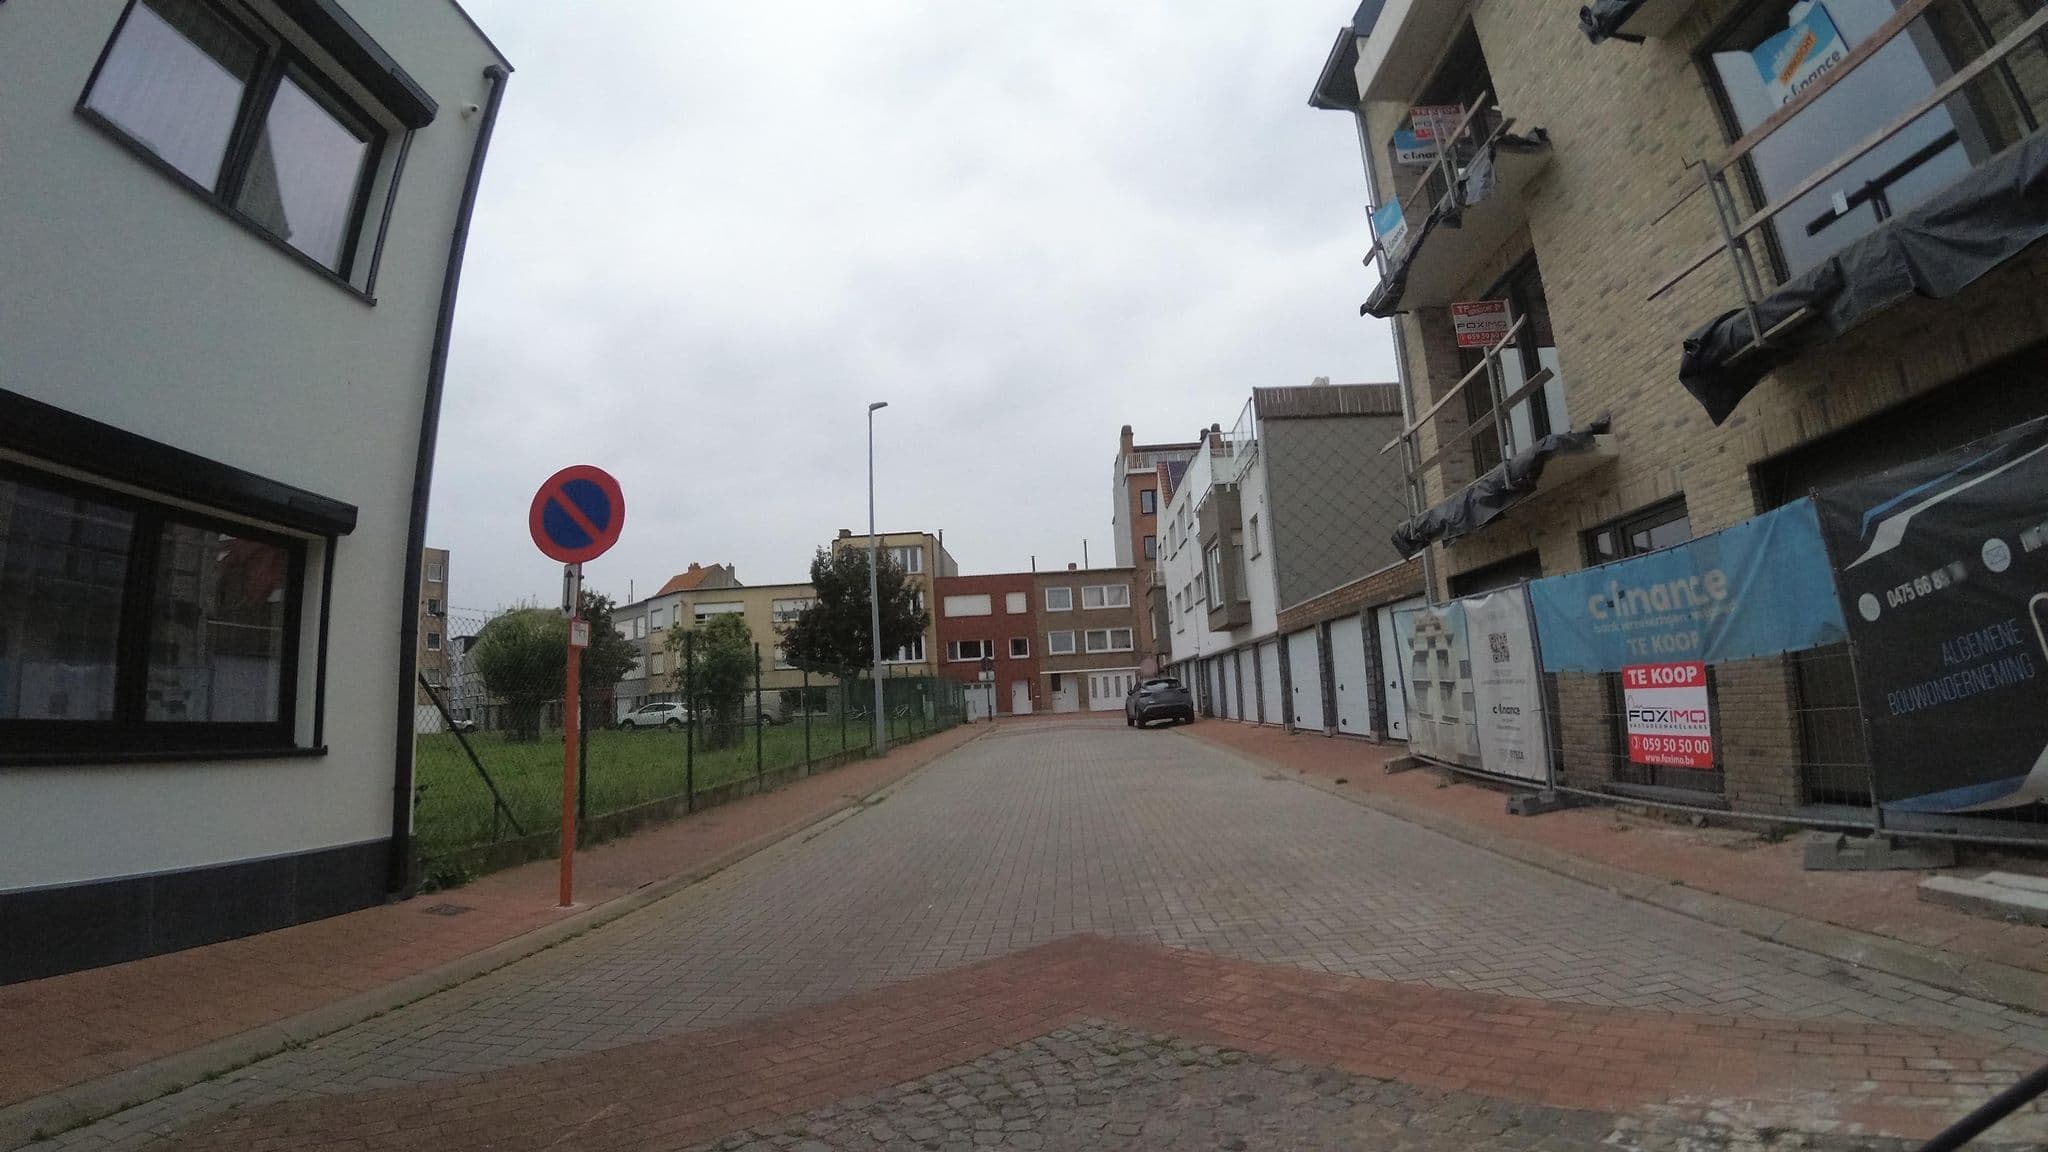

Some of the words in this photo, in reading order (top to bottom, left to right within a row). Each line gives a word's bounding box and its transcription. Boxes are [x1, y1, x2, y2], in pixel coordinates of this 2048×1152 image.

[1456, 320, 1507, 330] FOXIMO
[1886, 582, 1916, 608] 0475
[1913, 575, 1932, 597] 66
[1626, 637, 1649, 657] TE
[1651, 631, 1699, 654] KOOP
[1941, 618, 2024, 667] ALGEMENE
[1627, 668, 1648, 685] TE
[1650, 665, 1698, 684] KOOP
[1888, 652, 2035, 716] BOUWONDERNEMING
[1628, 709, 1706, 723] FOXIMO
[1642, 736, 1661, 752] 059
[1663, 738, 1677, 752] 50
[1678, 739, 1692, 753] 50
[1694, 739, 1709, 754] 00
[1645, 753, 1695, 766] www.foximo.be
